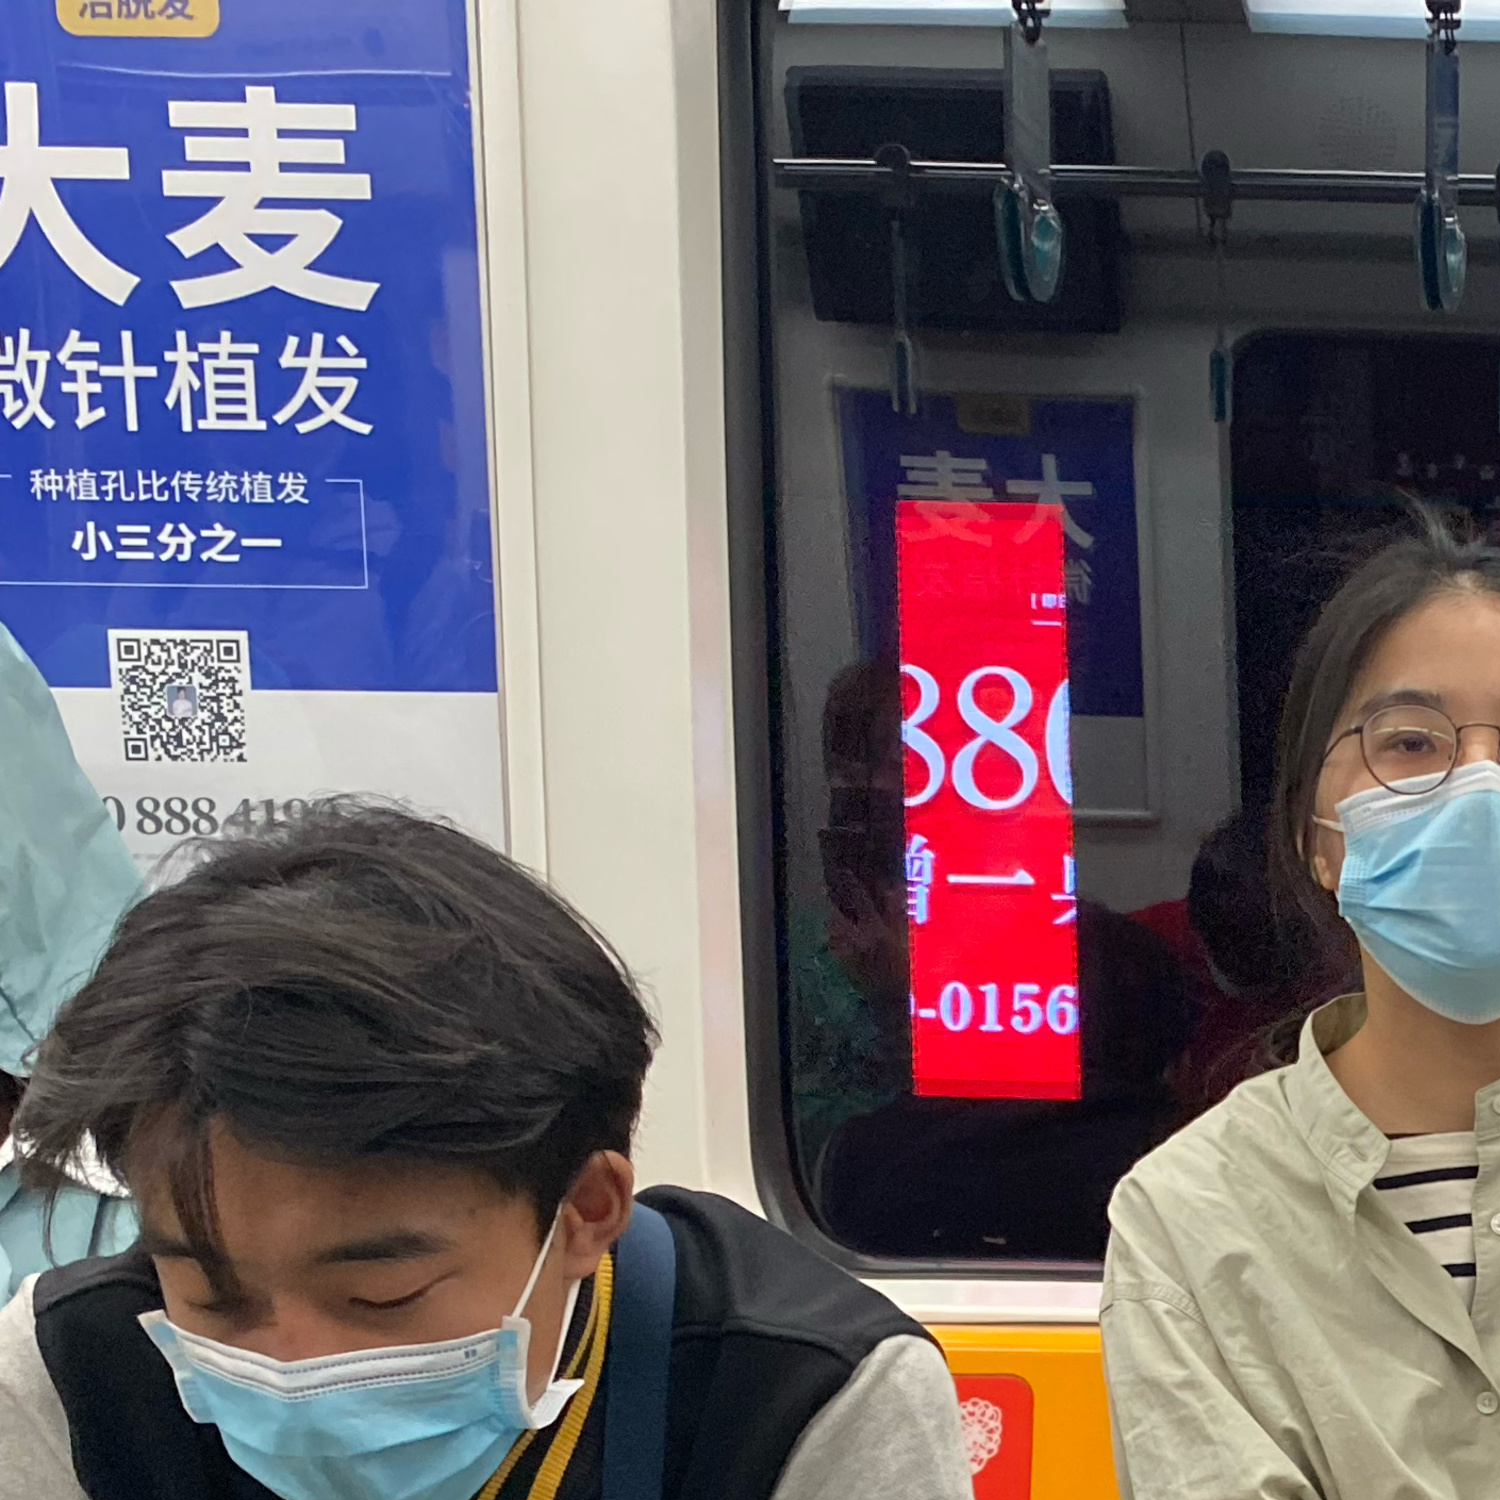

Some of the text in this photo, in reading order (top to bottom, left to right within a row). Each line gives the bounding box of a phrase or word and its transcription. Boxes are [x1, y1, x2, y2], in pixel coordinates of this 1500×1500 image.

[0, 82, 381, 312] 大麦
[30, 468, 310, 505] 种植孔比传统植发
[71, 521, 282, 562] 小三分之一
[135, 796, 219, 836] 888
